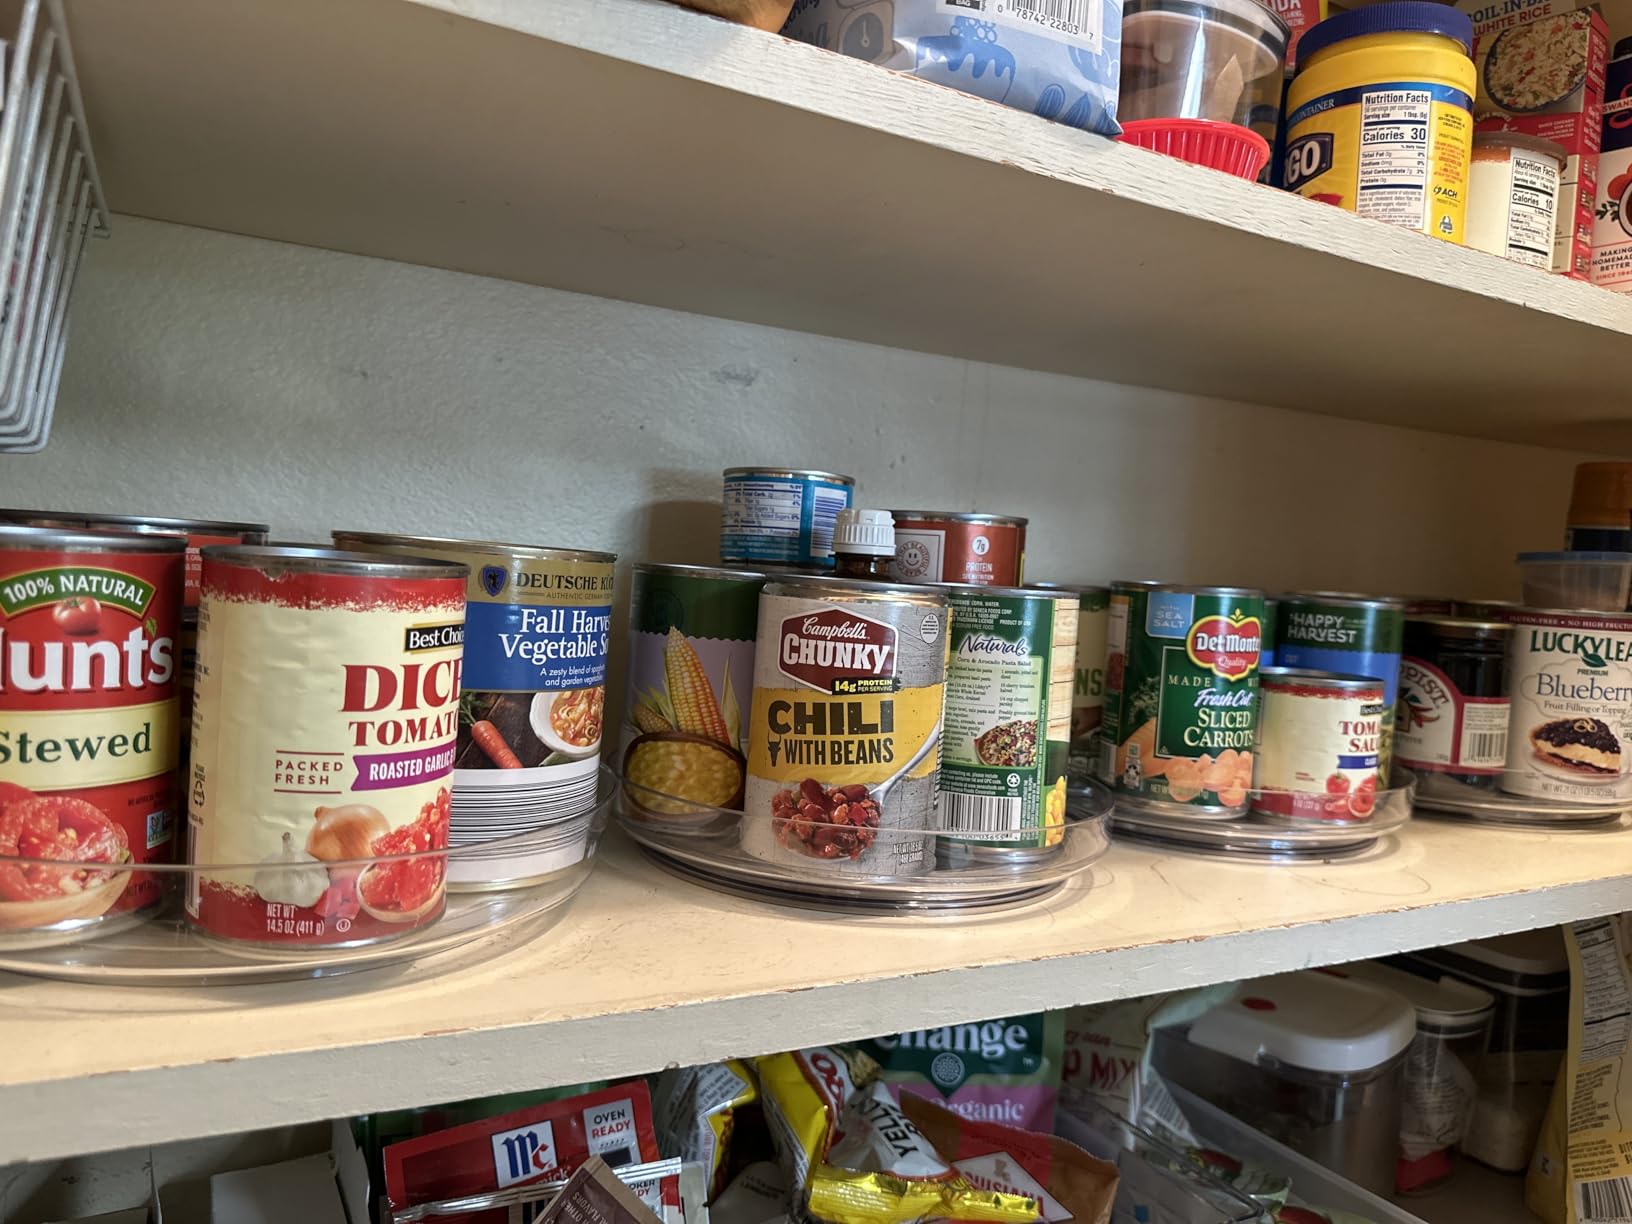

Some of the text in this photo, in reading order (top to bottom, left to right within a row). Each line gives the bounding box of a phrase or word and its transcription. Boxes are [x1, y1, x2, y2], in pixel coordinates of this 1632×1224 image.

[1015, 8, 1047, 26] 78742
[1049, 18, 1080, 35] 22803
[1519, 4, 1551, 22] RICE
[1473, 15, 1516, 36] WHITE
[1364, 92, 1429, 105] Nutrition Facts
[1363, 131, 1405, 142] Calories
[1410, 127, 1426, 140] 30
[1442, 188, 1458, 199] ACH
[1512, 192, 1539, 206] Calories
[1600, 261, 1631, 271] BETTER
[976, 540, 985, 552] 7g
[516, 572, 597, 591] DEUTSCHE
[3, 575, 145, 606] 100% NATURAL
[546, 591, 583, 600] AUTHENTIC
[519, 609, 565, 634] Fall
[1152, 619, 1185, 629] SALT
[1156, 611, 1183, 620] SEA
[1293, 612, 1345, 629] HAPPY
[801, 616, 870, 640] Campbell's
[1583, 621, 1604, 629] HIGH
[409, 629, 440, 649] Best
[1287, 625, 1358, 643] HARVEST
[498, 632, 598, 666] Vegetable
[782, 632, 891, 675] CHUNKY
[959, 634, 1029, 657] Naturals
[0, 617, 174, 693] unt's
[540, 668, 547, 676] A
[549, 668, 568, 678] zesty
[568, 665, 585, 676] blend
[1577, 668, 1609, 677] PREMIUM
[545, 677, 560, 687] and
[834, 680, 858, 693] 14g
[857, 679, 893, 687] PROTEIN
[1168, 675, 1213, 688] MADE
[1194, 688, 1254, 708] Fresh Cut
[1544, 700, 1564, 710] Fruit
[1565, 702, 1592, 713] Filling
[767, 700, 894, 735] CHILI
[1197, 708, 1251, 728] SLICED
[1184, 726, 1254, 748] CARROTS
[784, 737, 894, 765] WITH BEANS
[275, 759, 344, 772] PACKED
[369, 758, 423, 781] ROASTED
[425, 750, 450, 774] GARLIC
[275, 773, 330, 785] FRESH
[267, 903, 281, 918] NET
[267, 918, 283, 934] 14.5
[284, 919, 296, 934] OZ
[594, 1108, 626, 1125] OVEN
[591, 1119, 632, 1140] READY
